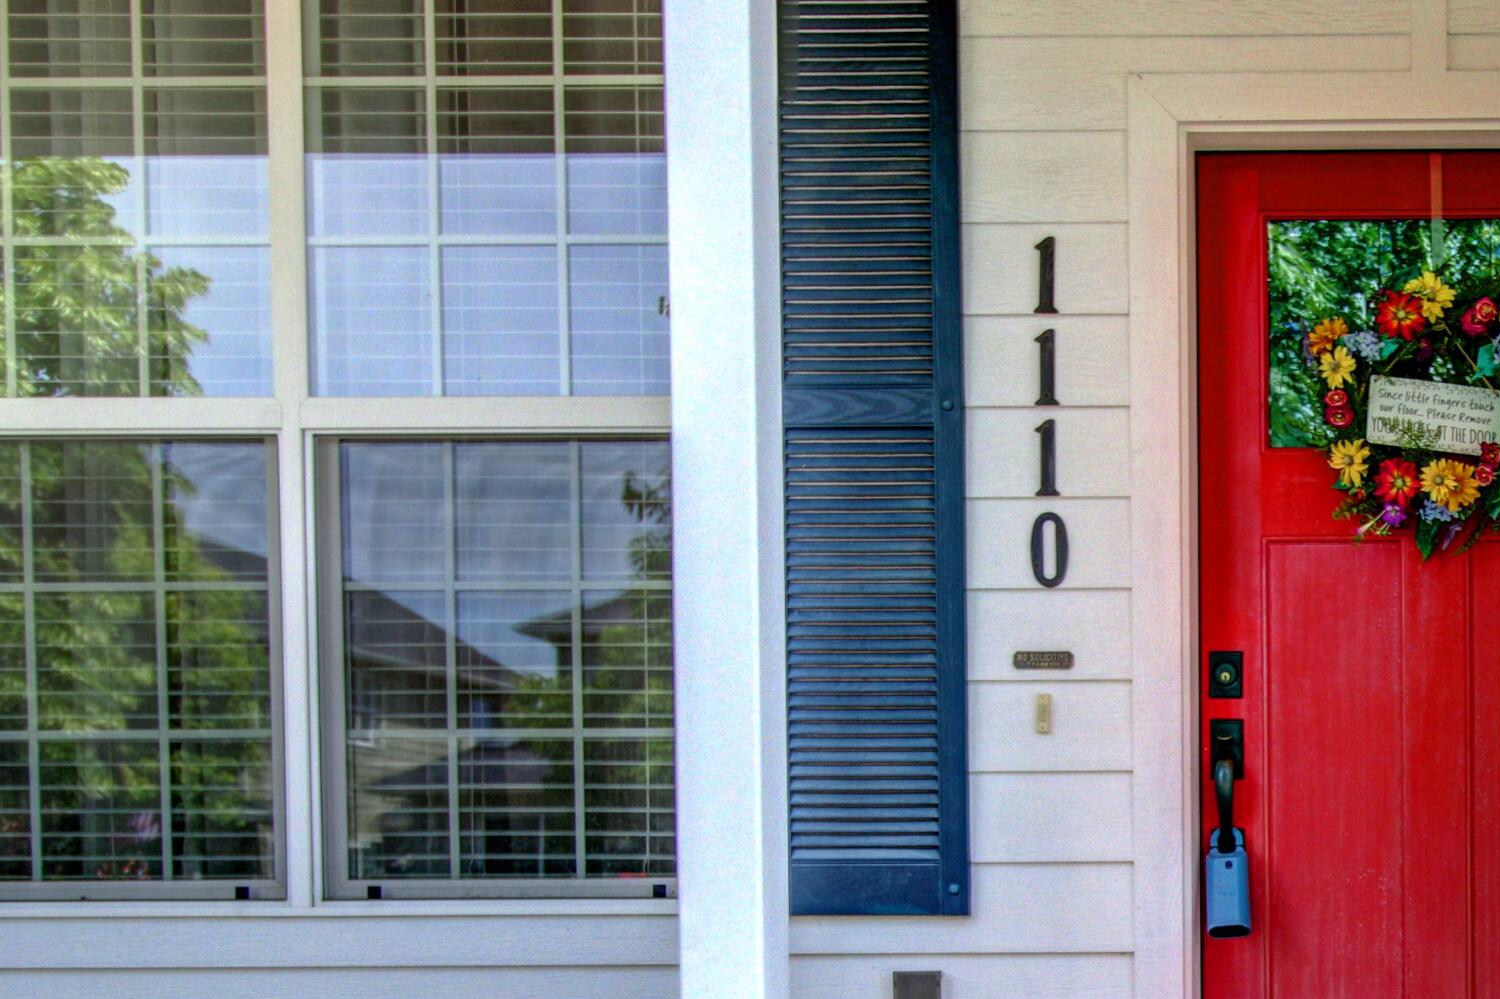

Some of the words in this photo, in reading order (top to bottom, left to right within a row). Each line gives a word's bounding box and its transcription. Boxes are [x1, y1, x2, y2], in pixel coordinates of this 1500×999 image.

[1378, 388, 1403, 400] Since
[1404, 391, 1430, 404] little
[1469, 398, 1495, 412] touch
[1031, 236, 1069, 588] 1110
[1379, 403, 1394, 412] our
[1427, 408, 1456, 421] Please
[1458, 412, 1492, 425] Remove
[1450, 427, 1466, 444] THE
